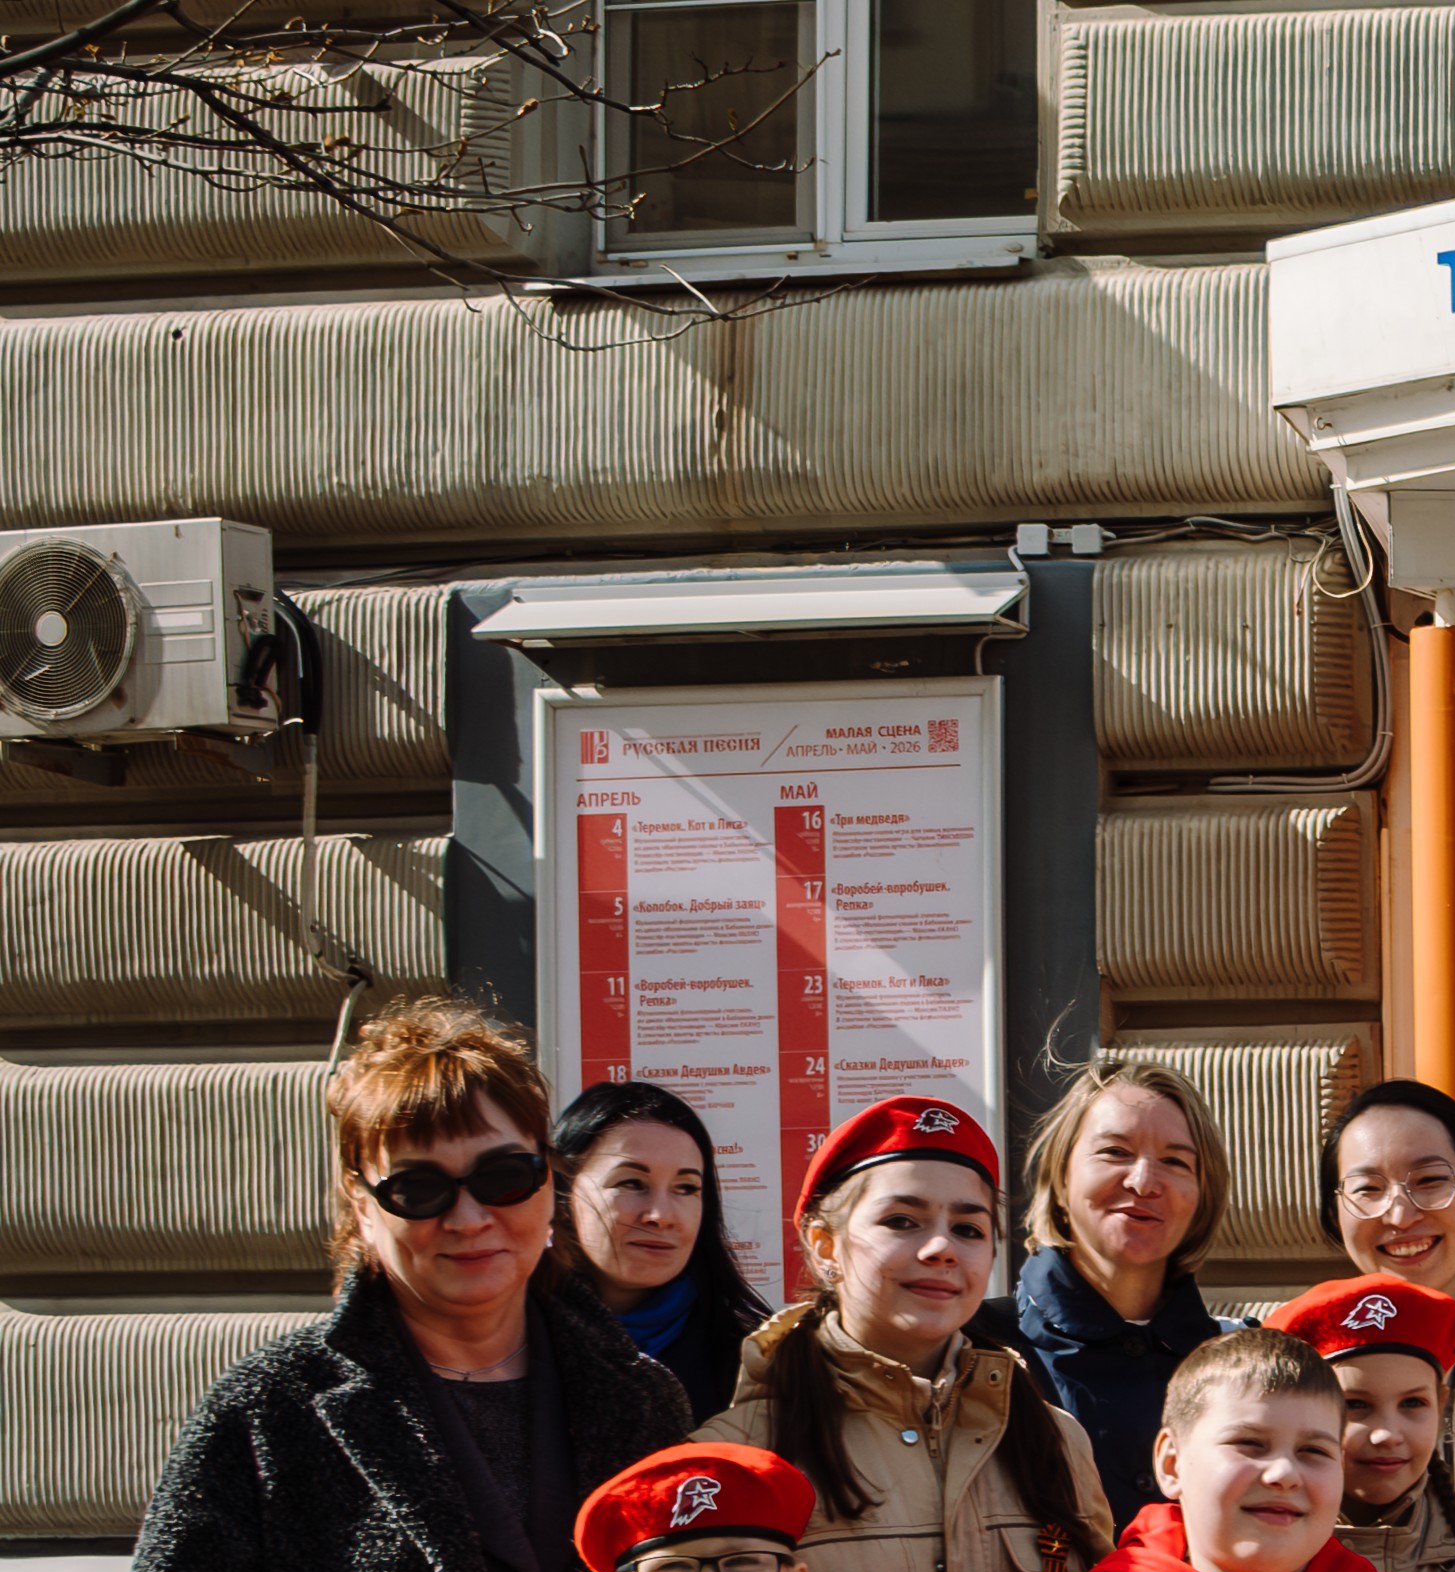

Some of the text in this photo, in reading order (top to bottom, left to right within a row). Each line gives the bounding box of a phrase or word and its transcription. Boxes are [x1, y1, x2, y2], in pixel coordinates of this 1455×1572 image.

[826, 725, 921, 739] МАЛАЯ СЦЕНА
[623, 738, 760, 759] РУССКАЯ ПЕСНЯ
[786, 741, 921, 757] АПРЕЛЬ МАЙ 2026
[577, 791, 641, 807] АПРЕЛЬ
[780, 782, 818, 800] МАЙ
[612, 819, 622, 837] 4
[802, 811, 821, 829] 16
[804, 881, 822, 900] 17
[614, 897, 623, 916] 5
[607, 977, 625, 996] 11
[803, 975, 823, 994] 23
[681, 1065, 730, 1079] Дедушки
[805, 1056, 825, 1075] 24
[879, 1057, 928, 1072] Дедушки
[607, 1065, 626, 1083] 18
